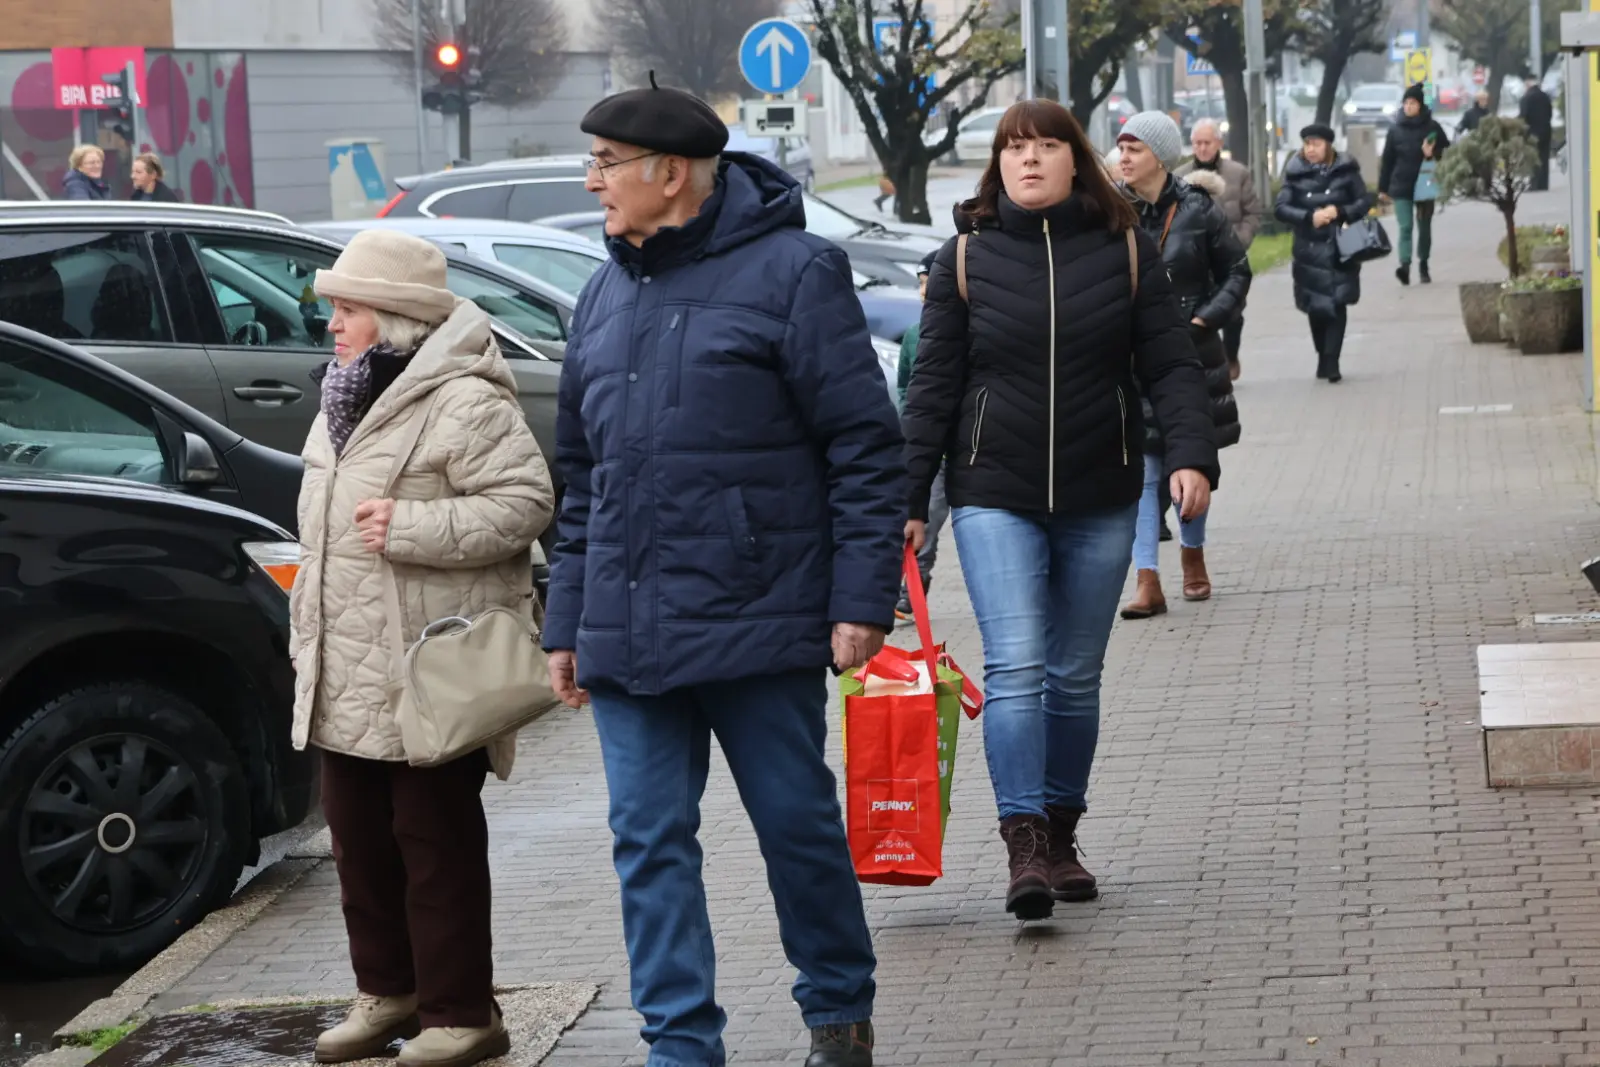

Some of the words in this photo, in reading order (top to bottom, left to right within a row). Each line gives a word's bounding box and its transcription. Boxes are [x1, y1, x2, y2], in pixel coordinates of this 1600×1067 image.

[60, 84, 87, 105] BIPA
[91, 84, 141, 105] BIP
[874, 853, 915, 863] penny.at
